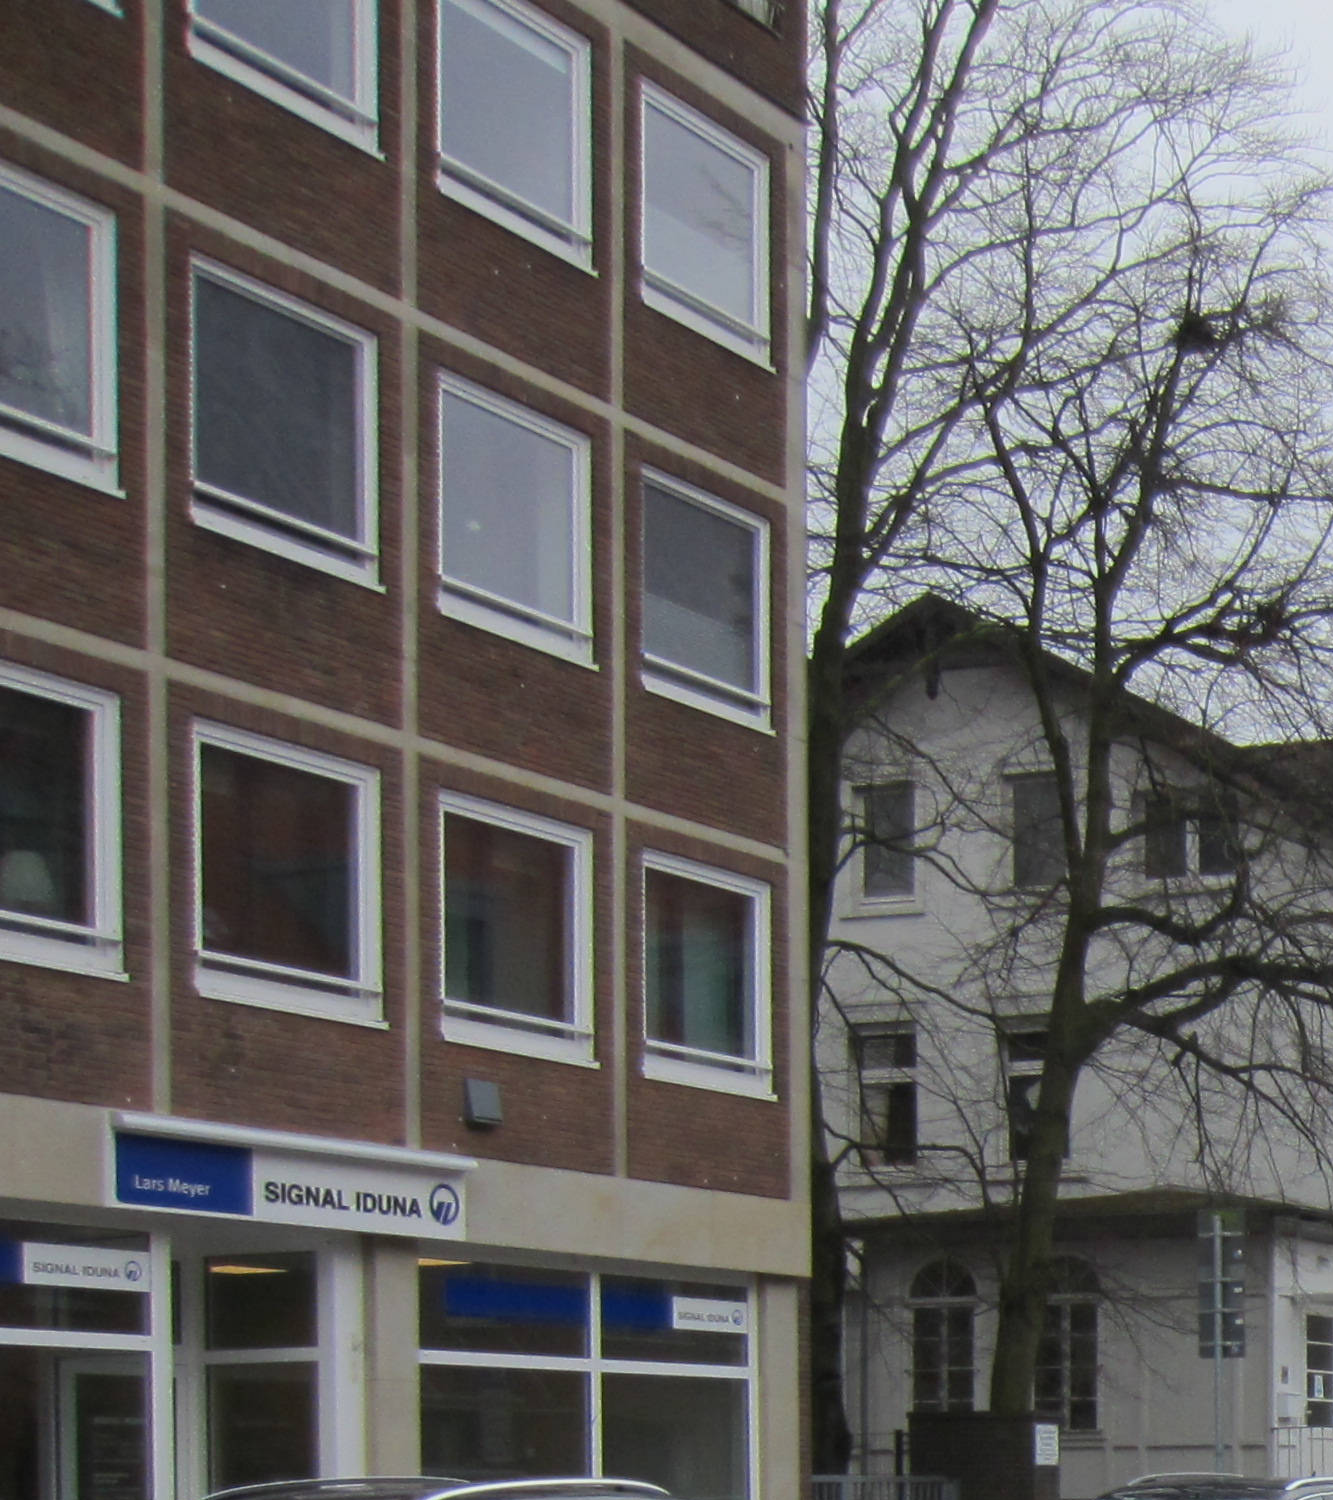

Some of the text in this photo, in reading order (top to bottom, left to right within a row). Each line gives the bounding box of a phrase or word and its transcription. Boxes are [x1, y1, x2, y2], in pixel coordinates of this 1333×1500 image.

[134, 1174, 212, 1198] Lars Meyer
[264, 1180, 422, 1218] SIGNAL IDUNA
[31, 1261, 120, 1278] SIGNAL IDUNA
